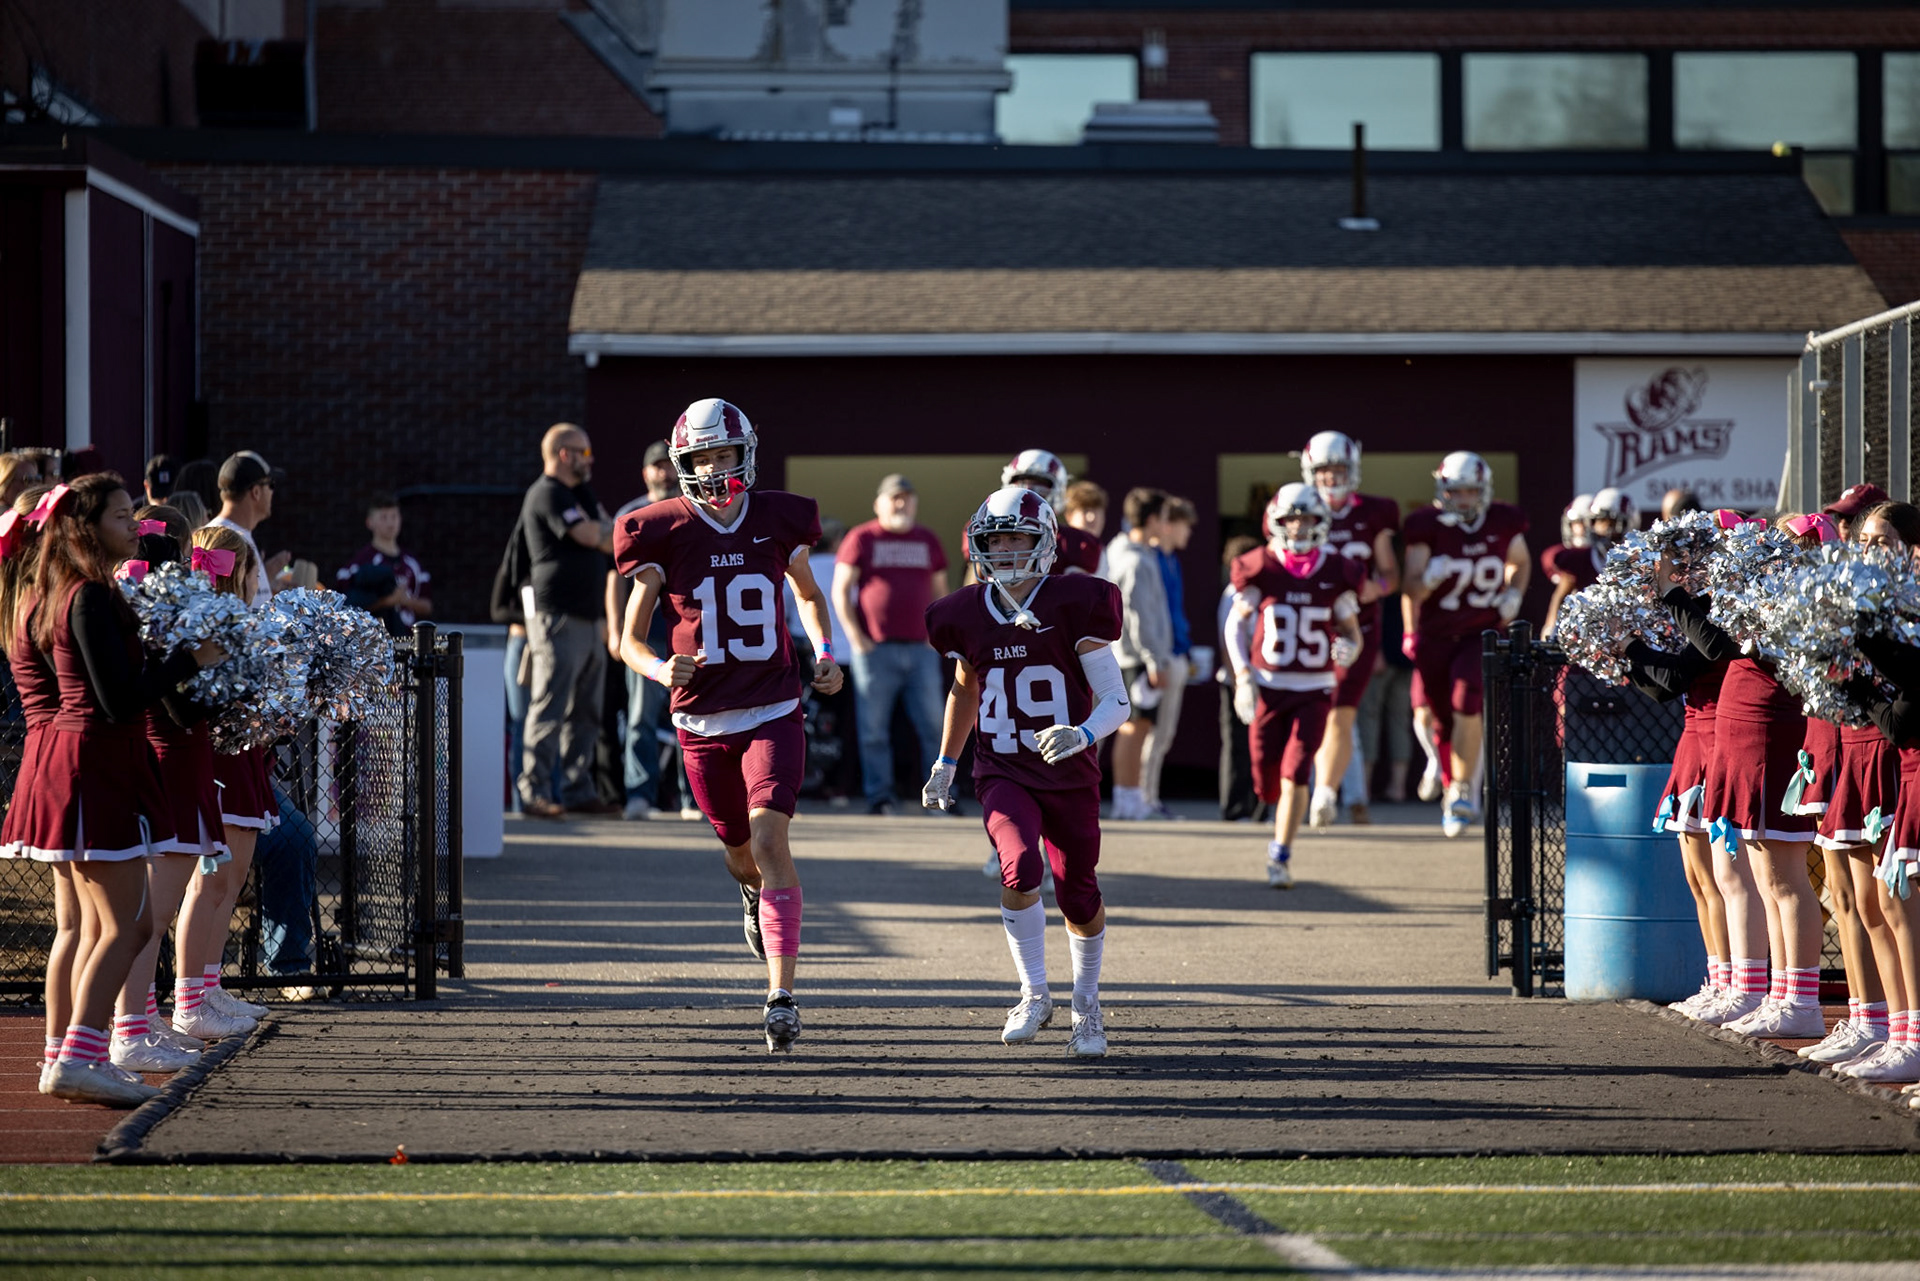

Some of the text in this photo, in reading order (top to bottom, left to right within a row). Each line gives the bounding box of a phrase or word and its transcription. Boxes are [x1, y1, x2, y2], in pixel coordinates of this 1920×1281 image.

[1615, 427, 1723, 478] RAMS
[1731, 478, 1780, 502] SHA
[710, 553, 745, 568] RAMS
[1440, 555, 1505, 611] 79
[693, 573, 778, 665] 19
[1261, 604, 1332, 668] 85
[993, 645, 1028, 660] RAMS
[979, 664, 1071, 754] 49
